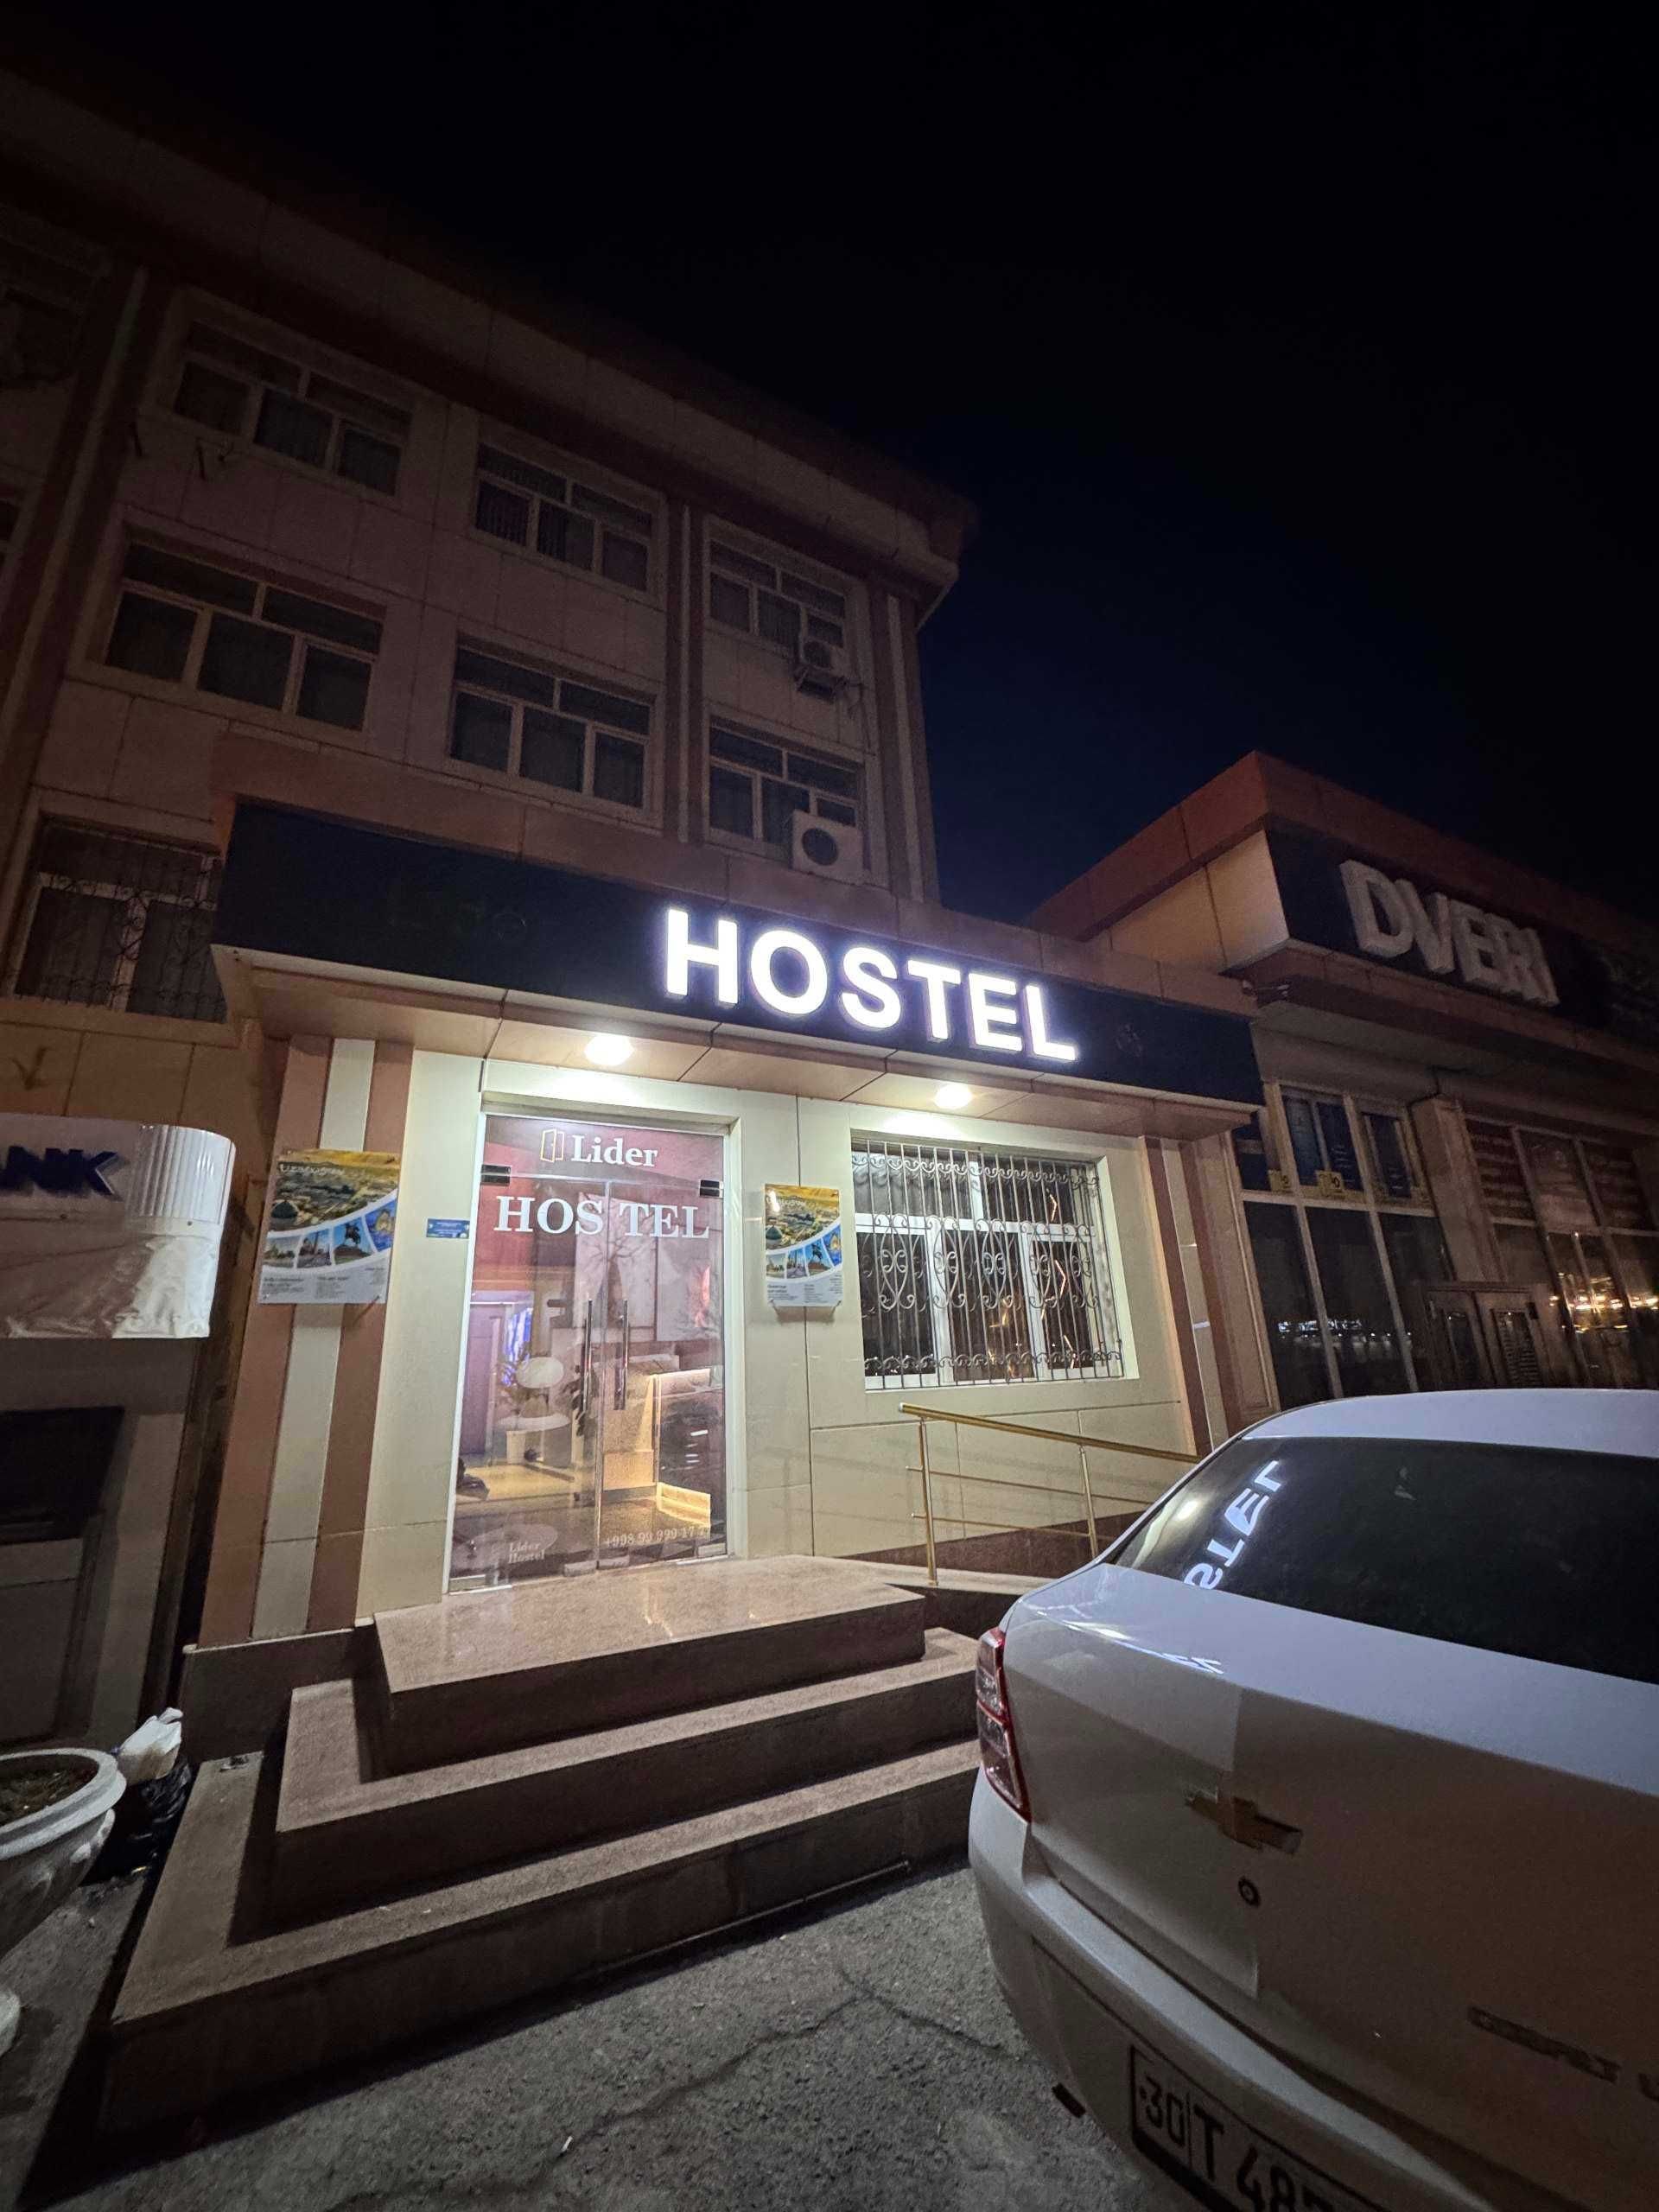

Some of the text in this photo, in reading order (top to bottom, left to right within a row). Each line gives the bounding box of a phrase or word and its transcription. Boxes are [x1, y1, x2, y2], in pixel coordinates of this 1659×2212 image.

[1339, 859, 1561, 1007] DVERI
[664, 906, 1078, 1063] HOSTEL
[570, 1133, 658, 1167] Lider
[493, 1194, 710, 1239] HOSTEL
[1193, 2103, 1225, 2183] T
